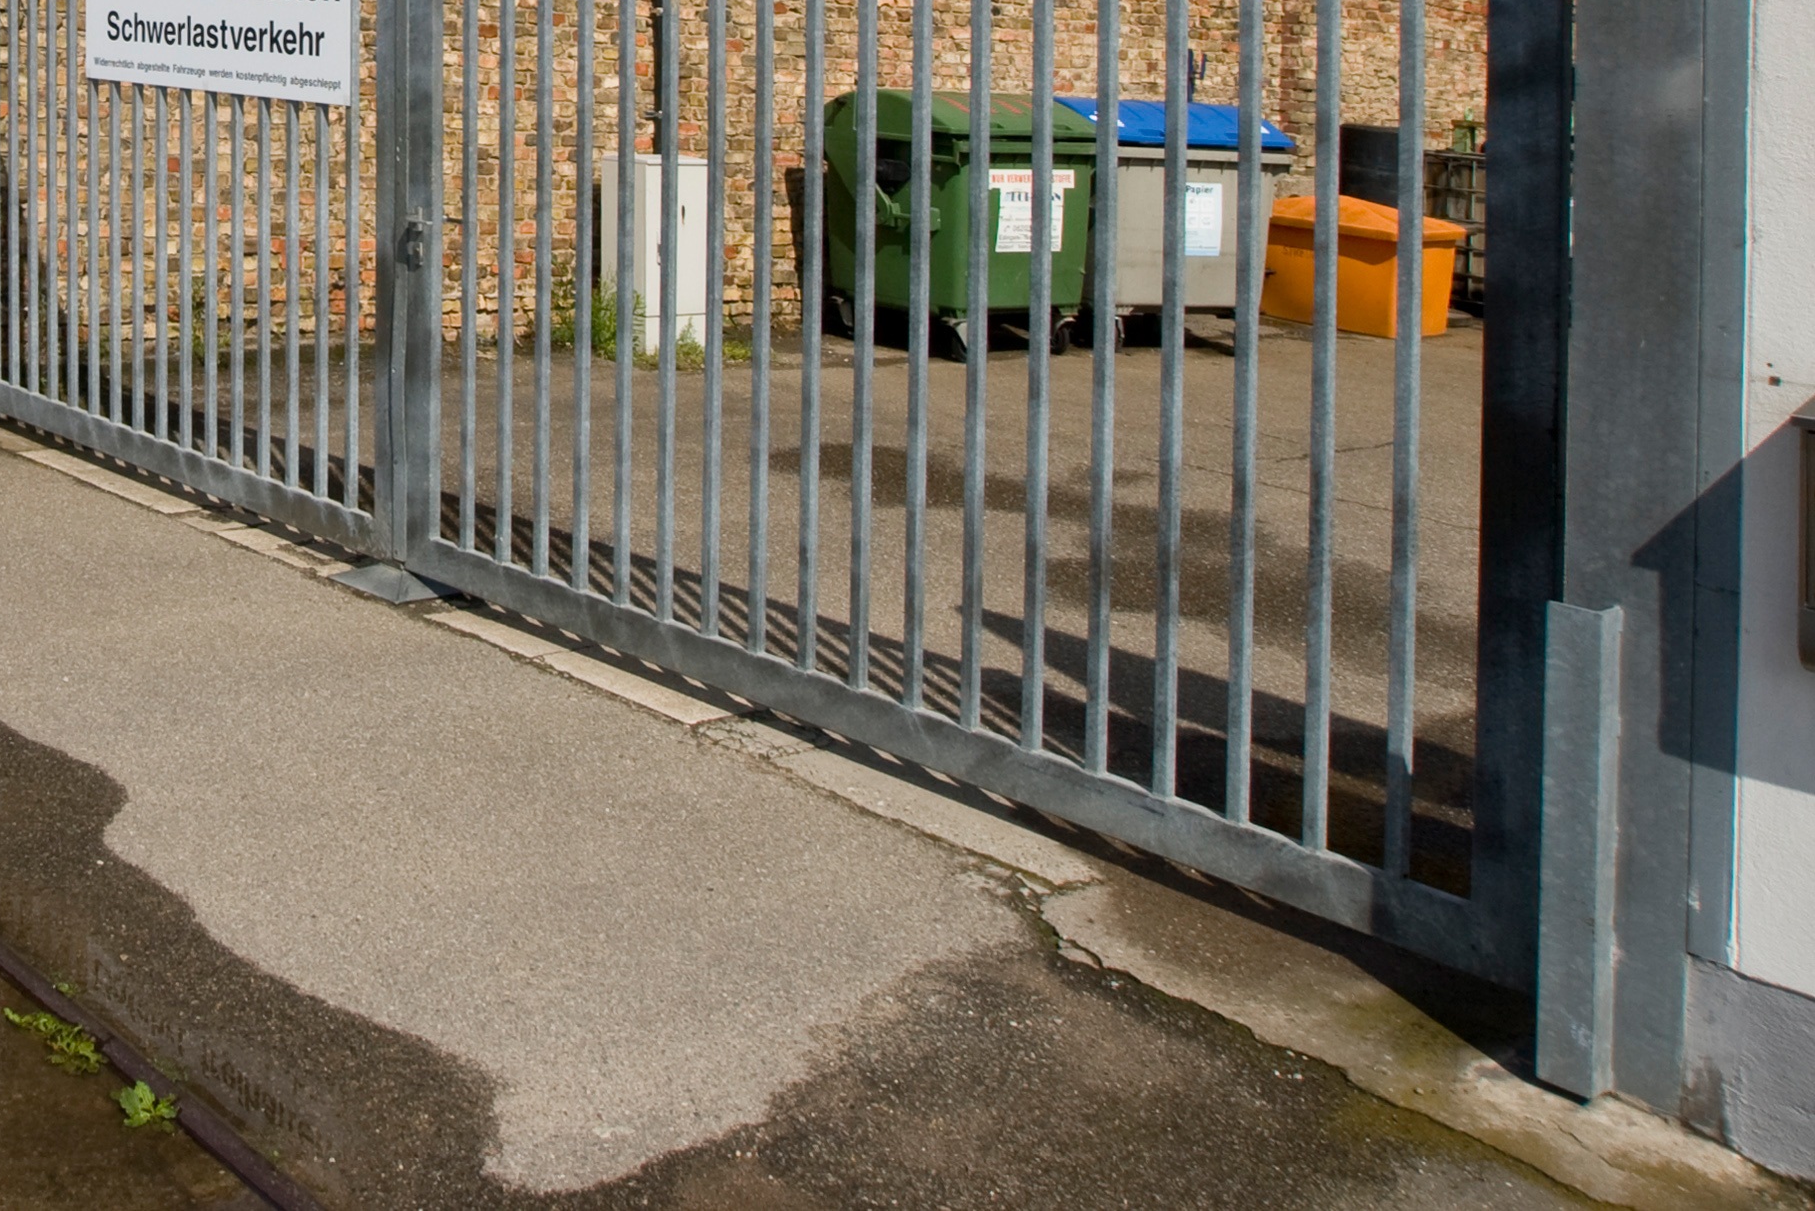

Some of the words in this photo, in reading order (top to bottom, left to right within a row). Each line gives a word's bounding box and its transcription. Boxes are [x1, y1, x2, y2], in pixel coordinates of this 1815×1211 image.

[107, 10, 325, 56] Schwerlastverkehr
[94, 57, 135, 69] Widerrechtlich
[137, 62, 171, 73] abgestellte
[173, 64, 206, 79] Fahrzeuge
[208, 69, 233, 79] werden
[235, 70, 287, 87] kostenpflichtig
[290, 75, 341, 91] abgeschleppt
[1185, 185, 1214, 195] Papier
